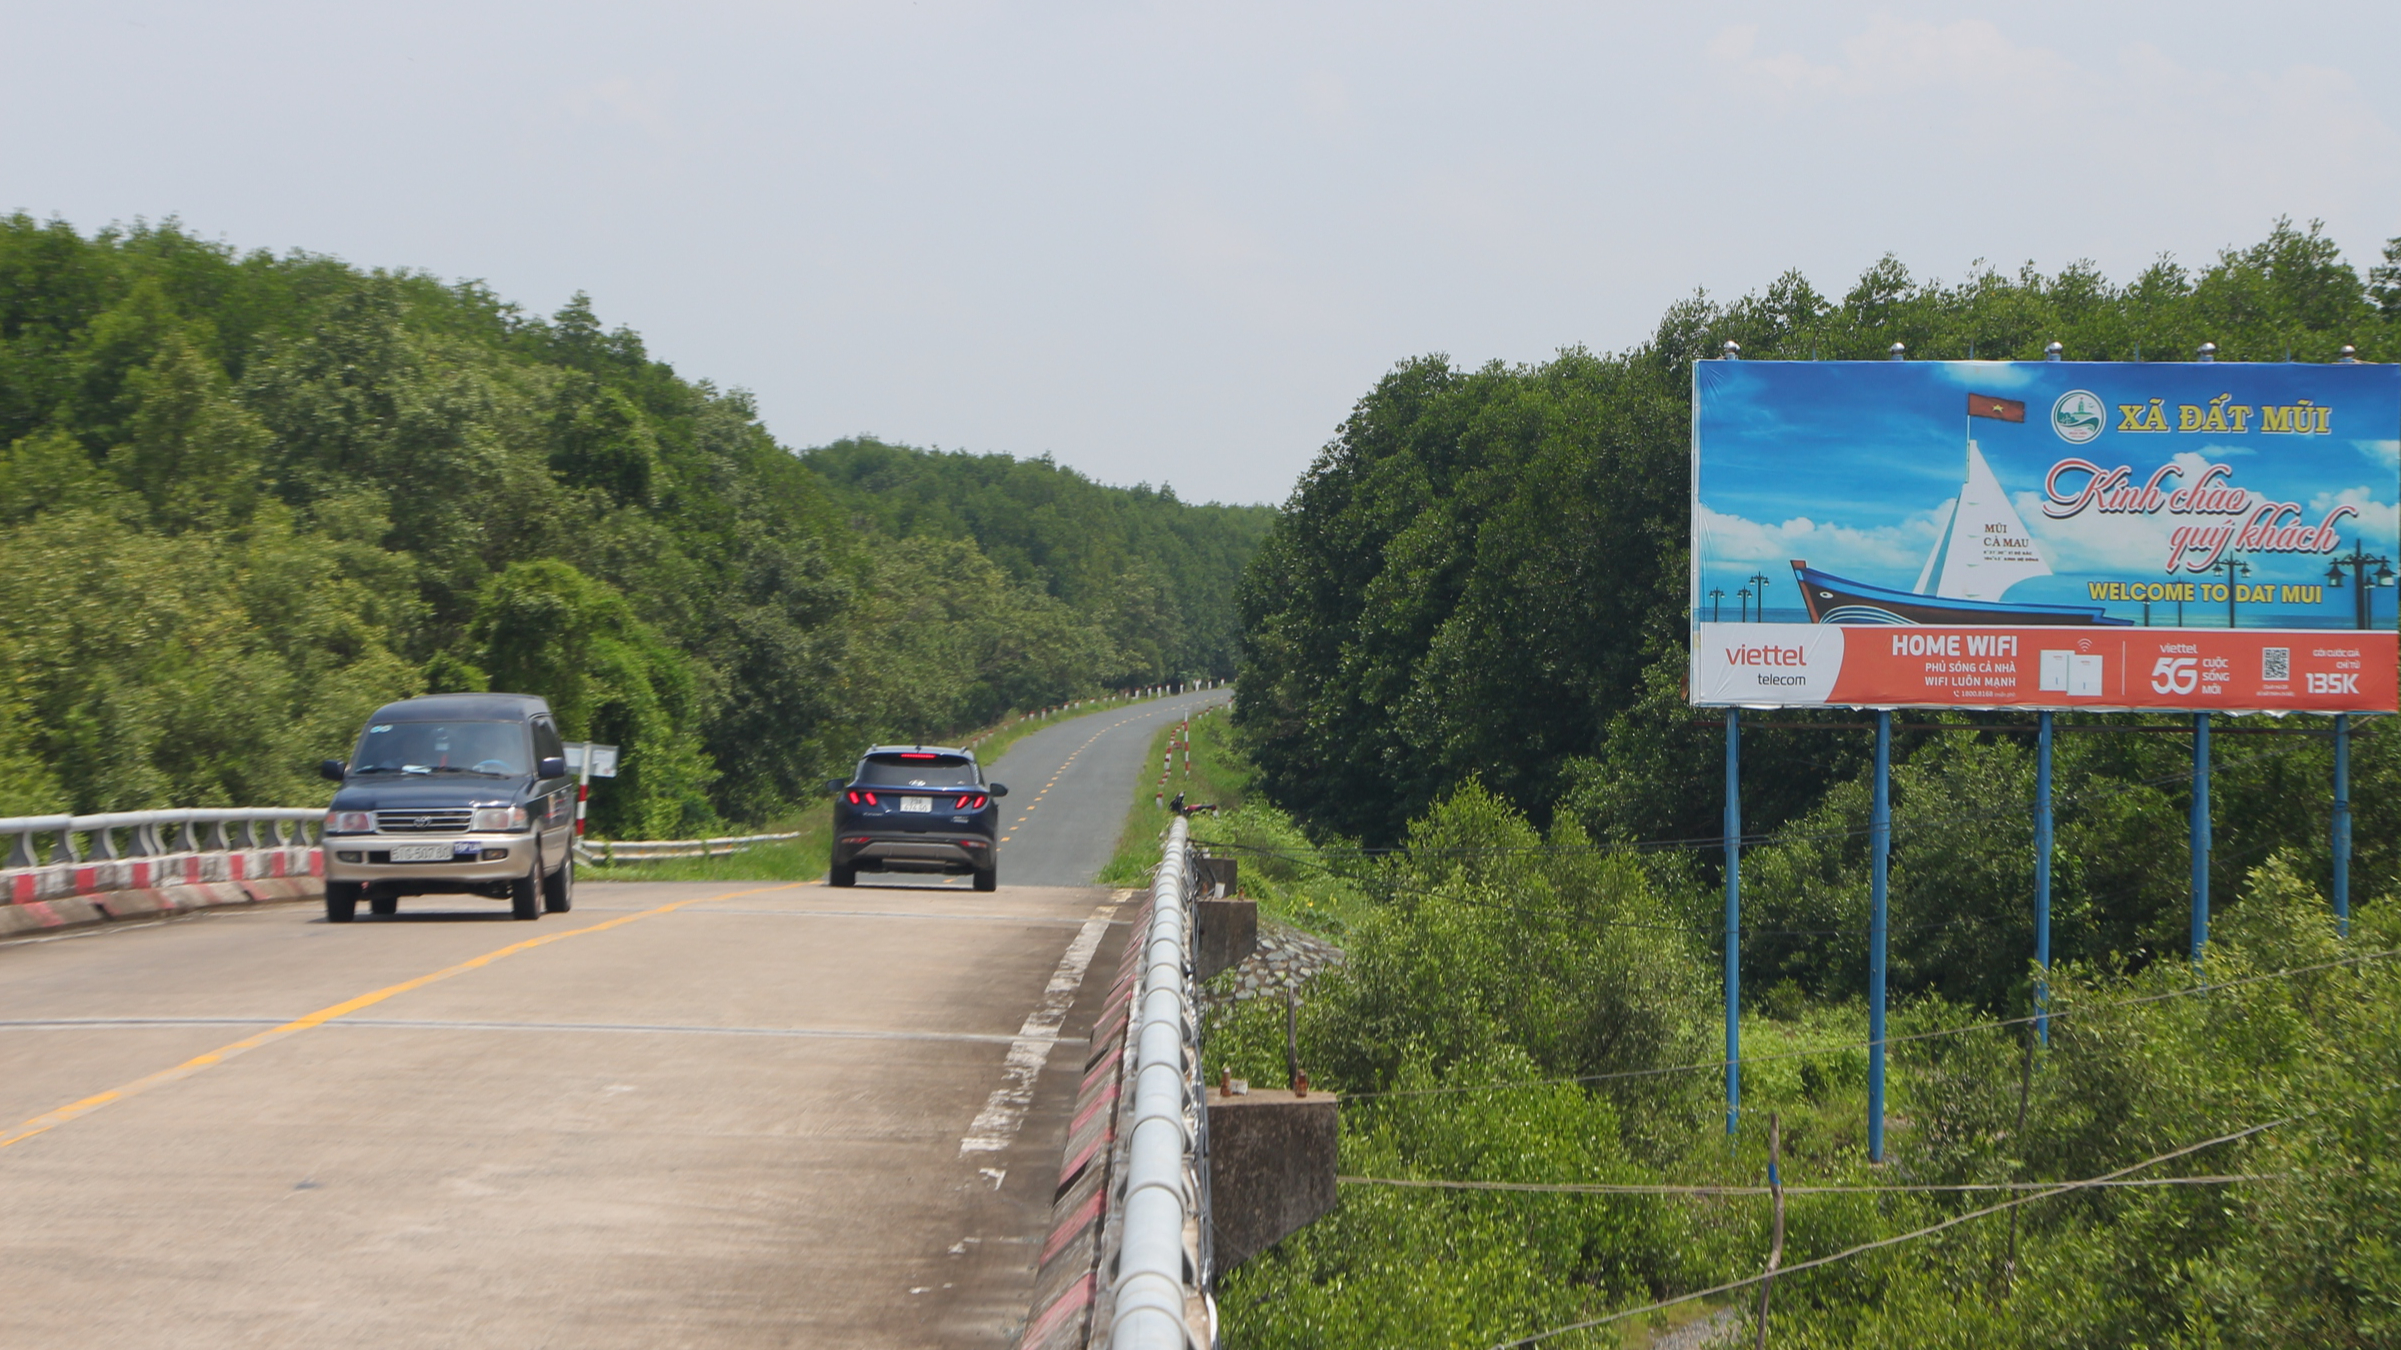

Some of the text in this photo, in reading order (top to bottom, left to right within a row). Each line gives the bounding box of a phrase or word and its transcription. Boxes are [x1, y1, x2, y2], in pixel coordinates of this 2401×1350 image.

[2117, 392, 2331, 434] XÃ ĐẤT MŨI
[2042, 457, 2251, 519] Kính chào
[1983, 535, 2029, 548] CÀ MAU
[2166, 501, 2357, 574] quý khách
[2088, 581, 2323, 605] WELCOME TO DAT MUI
[1725, 643, 1807, 666] viettel
[1892, 634, 2018, 657] HOME WIFI
[2159, 643, 2198, 654] viettel
[1925, 660, 2016, 673] PHỦ SÓNG CẢ NHÀ
[2202, 656, 2229, 669] CUỘC
[1757, 673, 1806, 686] telecom
[1925, 674, 2016, 688] WIFI LUÔN MẠNH
[2151, 657, 2198, 695] 5G
[2202, 668, 2230, 682] SỐNG
[2305, 673, 2360, 694] 135K
